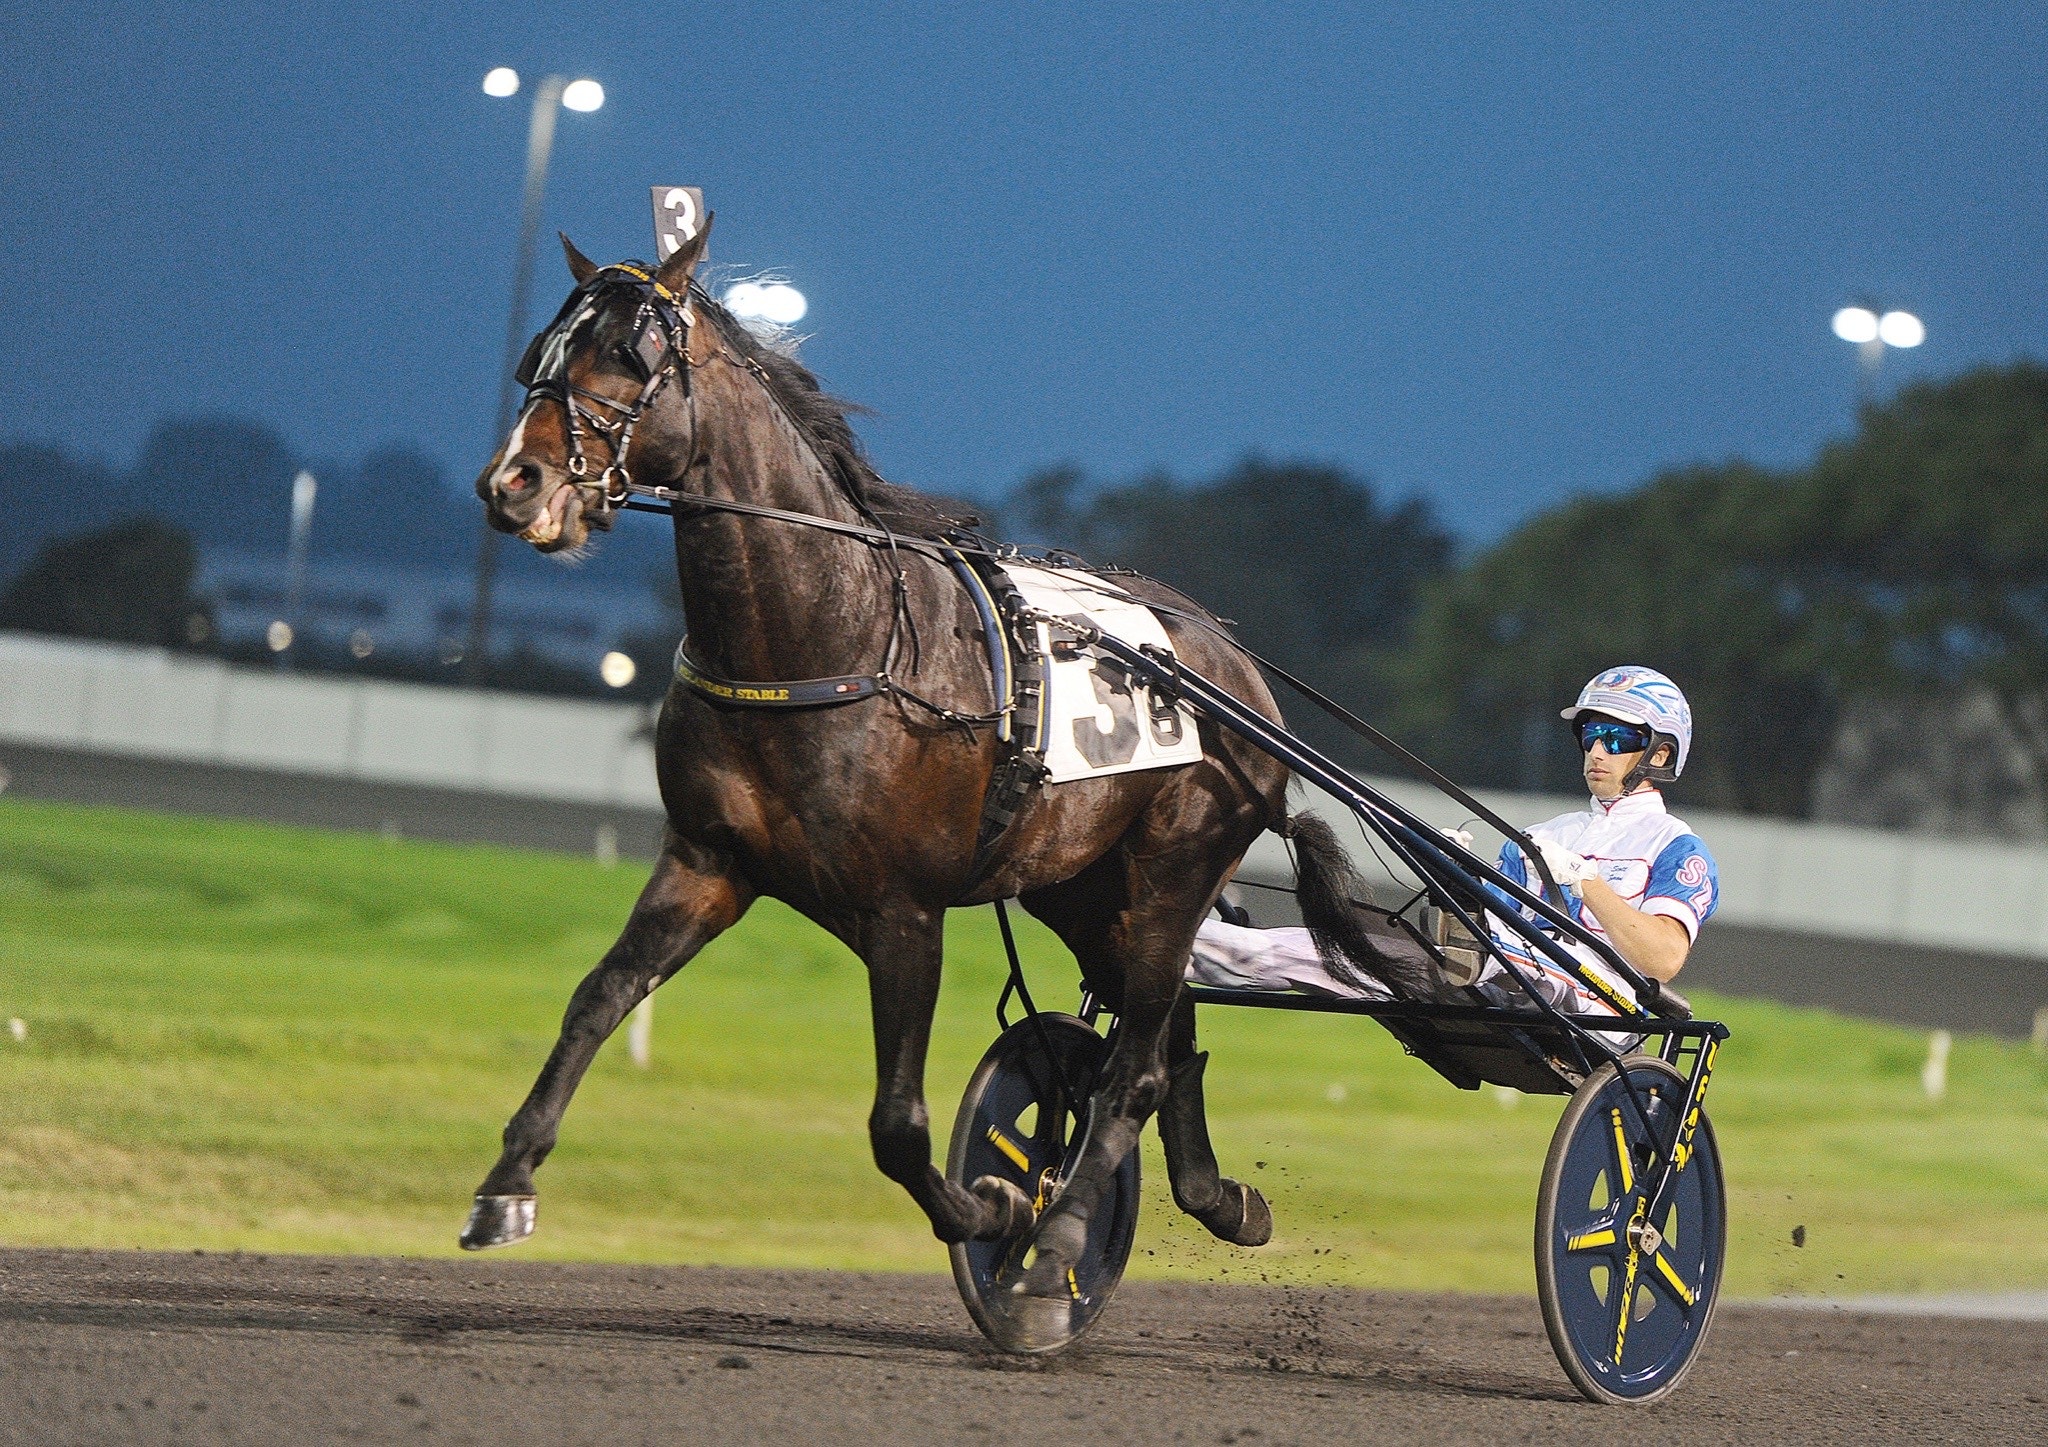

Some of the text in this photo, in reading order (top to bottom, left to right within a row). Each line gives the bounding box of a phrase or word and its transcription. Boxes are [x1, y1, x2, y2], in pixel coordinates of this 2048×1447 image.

[664, 187, 698, 254] 3
[735, 687, 790, 701] STABLE
[1049, 612, 1141, 769] 3
